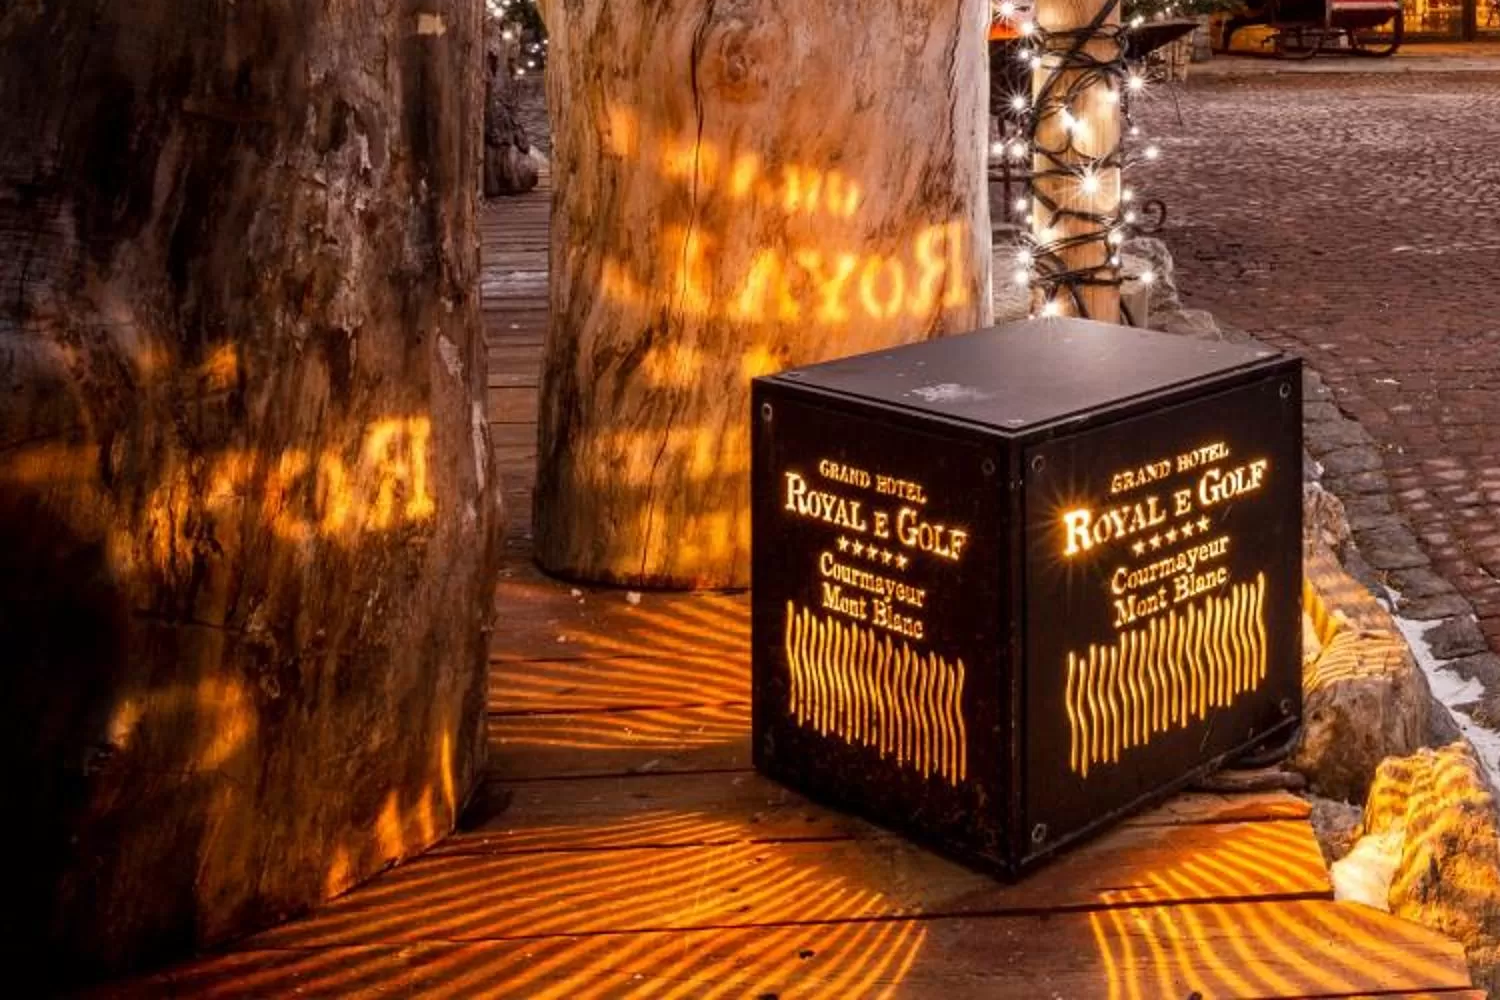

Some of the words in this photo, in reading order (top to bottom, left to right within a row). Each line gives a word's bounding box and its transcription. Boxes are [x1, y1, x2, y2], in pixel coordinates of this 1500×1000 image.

[818, 458, 871, 488] GRAND
[876, 473, 928, 504] HOTEL
[1111, 460, 1171, 493] GRAND
[1176, 441, 1230, 473] HOTEL
[784, 471, 867, 532] ROYAL
[874, 511, 890, 539] E
[897, 506, 968, 560] GOLF
[1063, 495, 1167, 556] ROYAL
[1174, 488, 1192, 517] E
[1199, 458, 1268, 506] GOLF
[820, 551, 926, 608] Courmayeur
[1110, 535, 1230, 595] Courmayeur
[821, 581, 867, 620] Mont
[872, 599, 924, 640] Blanc
[1112, 585, 1168, 629] Mont
[1172, 566, 1229, 603] Blanc
